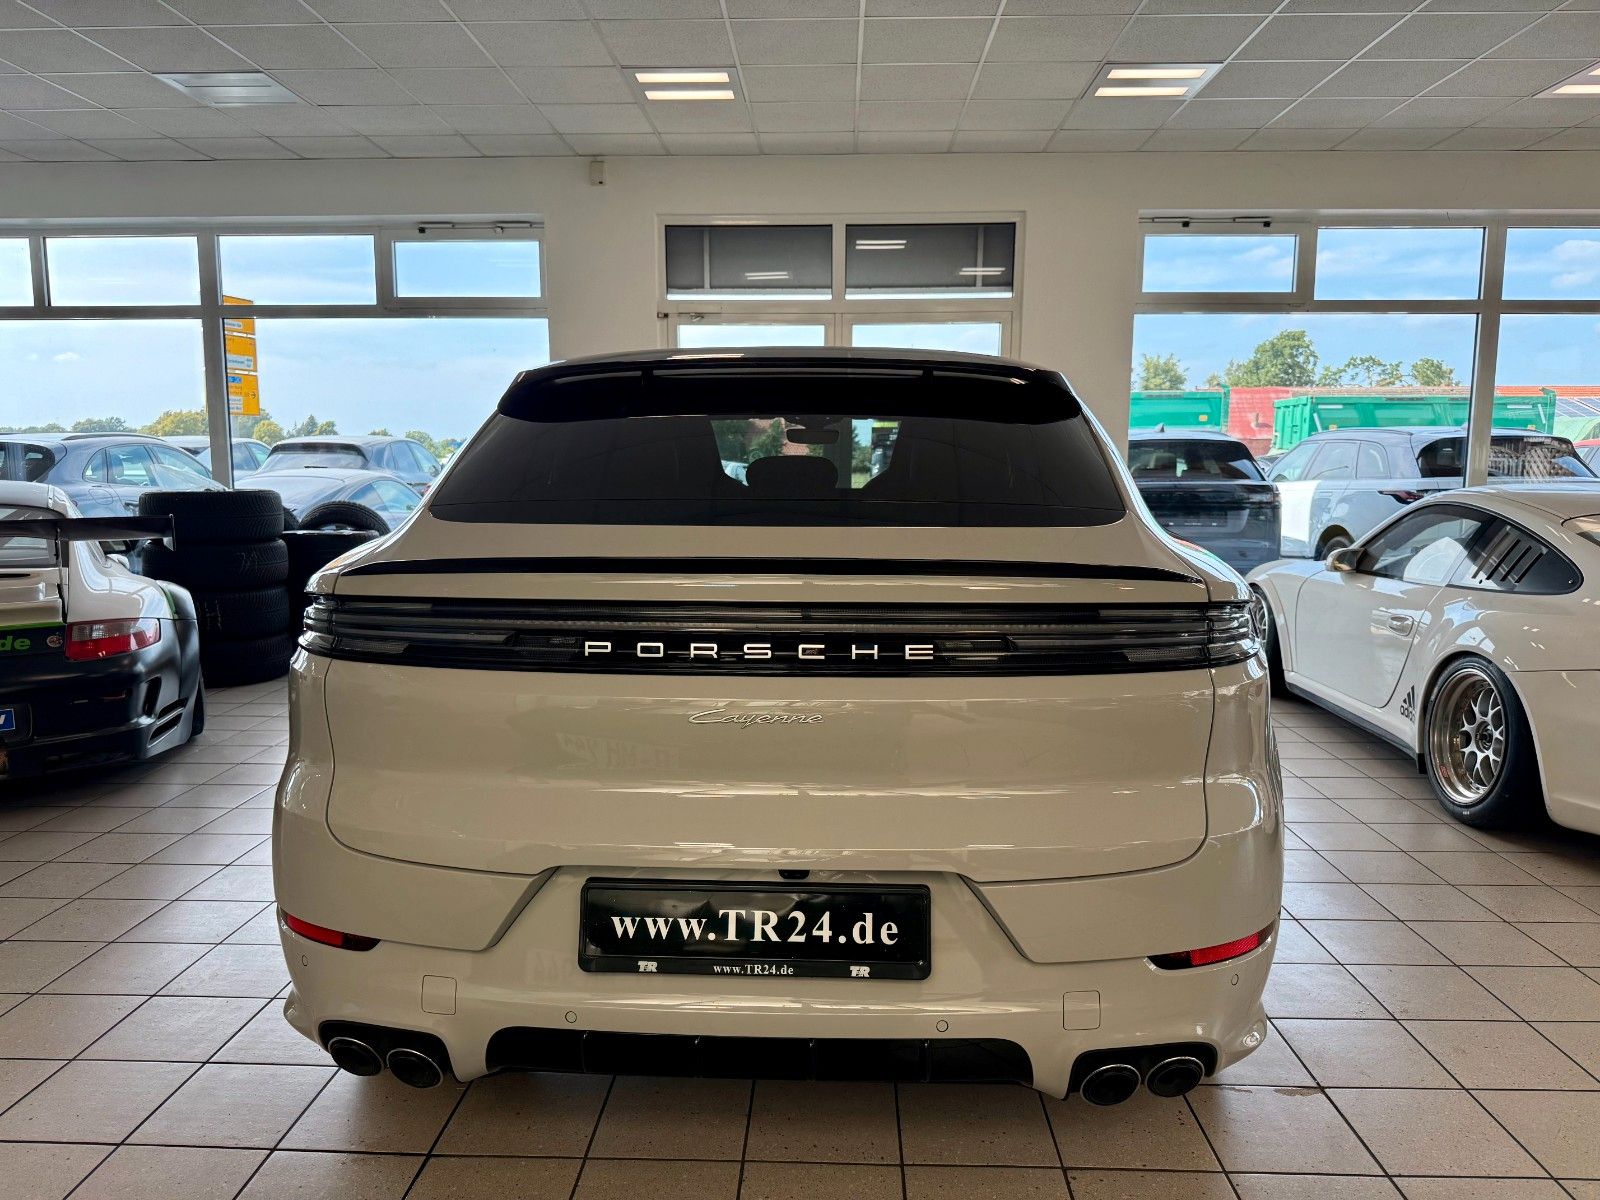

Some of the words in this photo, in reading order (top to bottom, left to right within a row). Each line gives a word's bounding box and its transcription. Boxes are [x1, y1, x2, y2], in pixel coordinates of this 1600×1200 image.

[584, 641, 934, 660] PORSCHE
[688, 708, 824, 729] Cayenne
[611, 909, 899, 945] www.TR24.de
[712, 963, 794, 976] www.TR24.de
